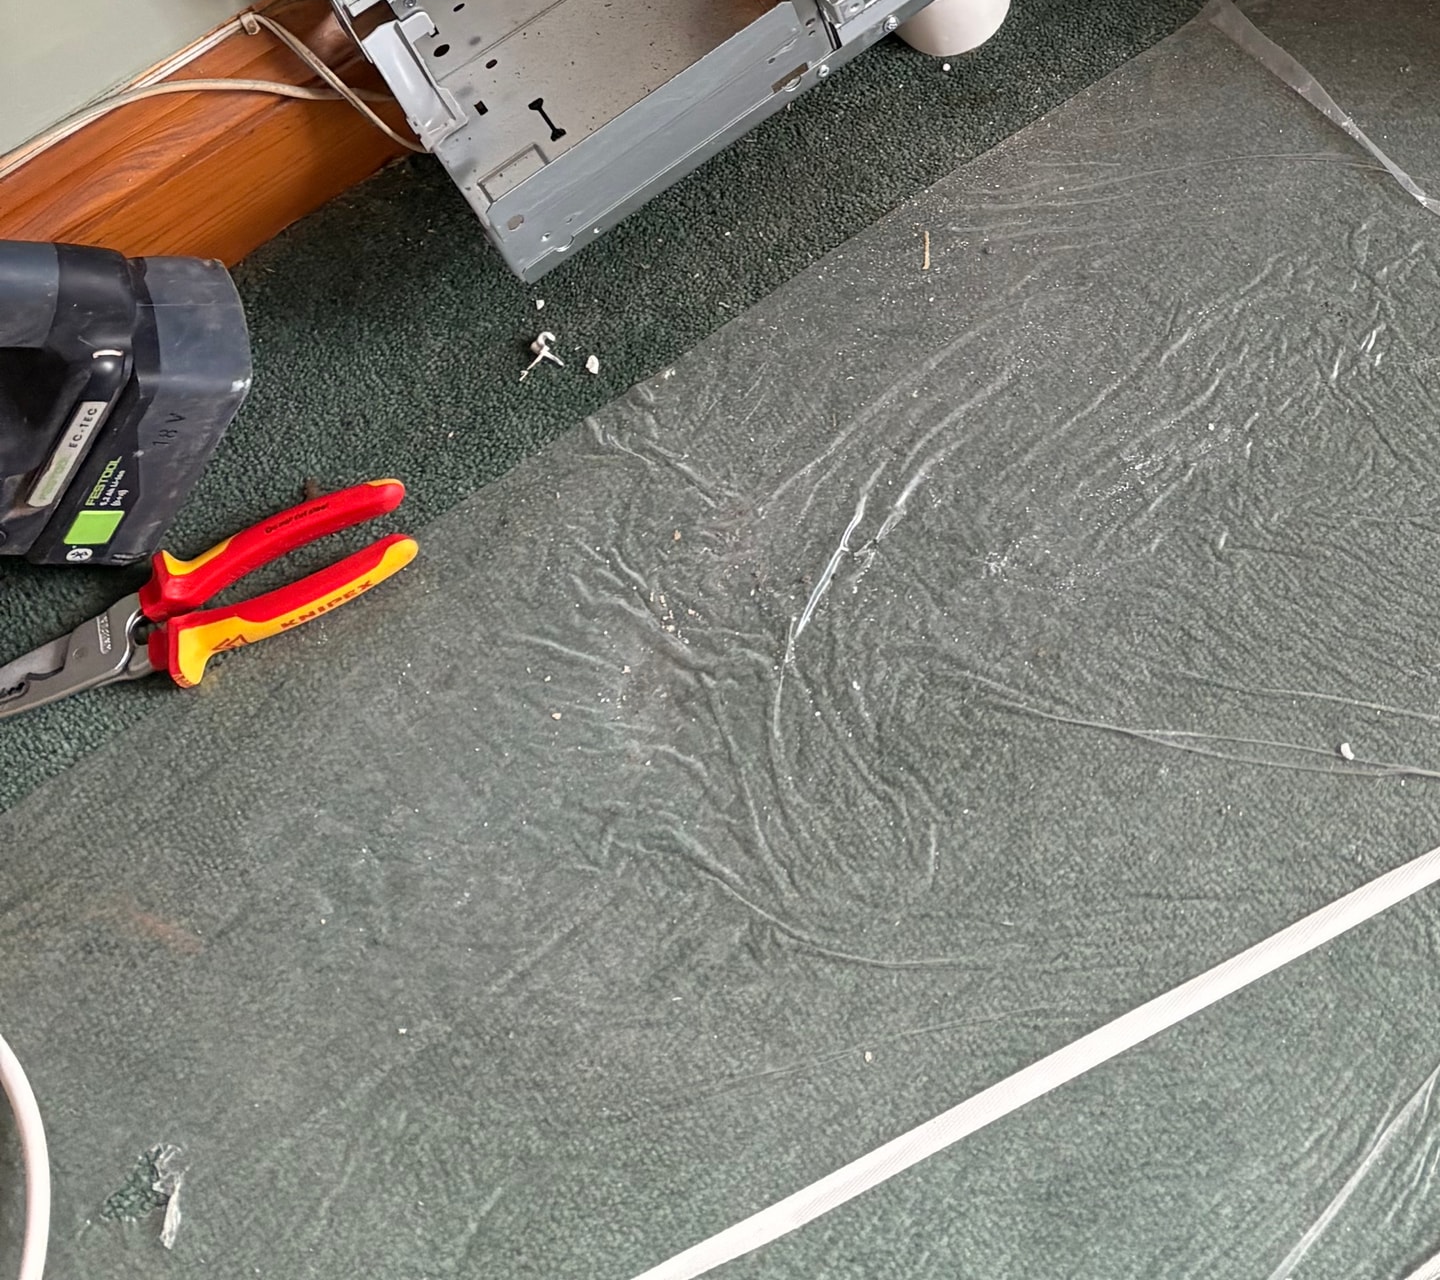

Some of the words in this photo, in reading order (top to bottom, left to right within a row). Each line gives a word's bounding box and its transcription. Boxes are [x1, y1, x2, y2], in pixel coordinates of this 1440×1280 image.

[169, 412, 186, 424] V
[85, 455, 123, 506] FESTOOL
[280, 580, 373, 629] KNIPEX
